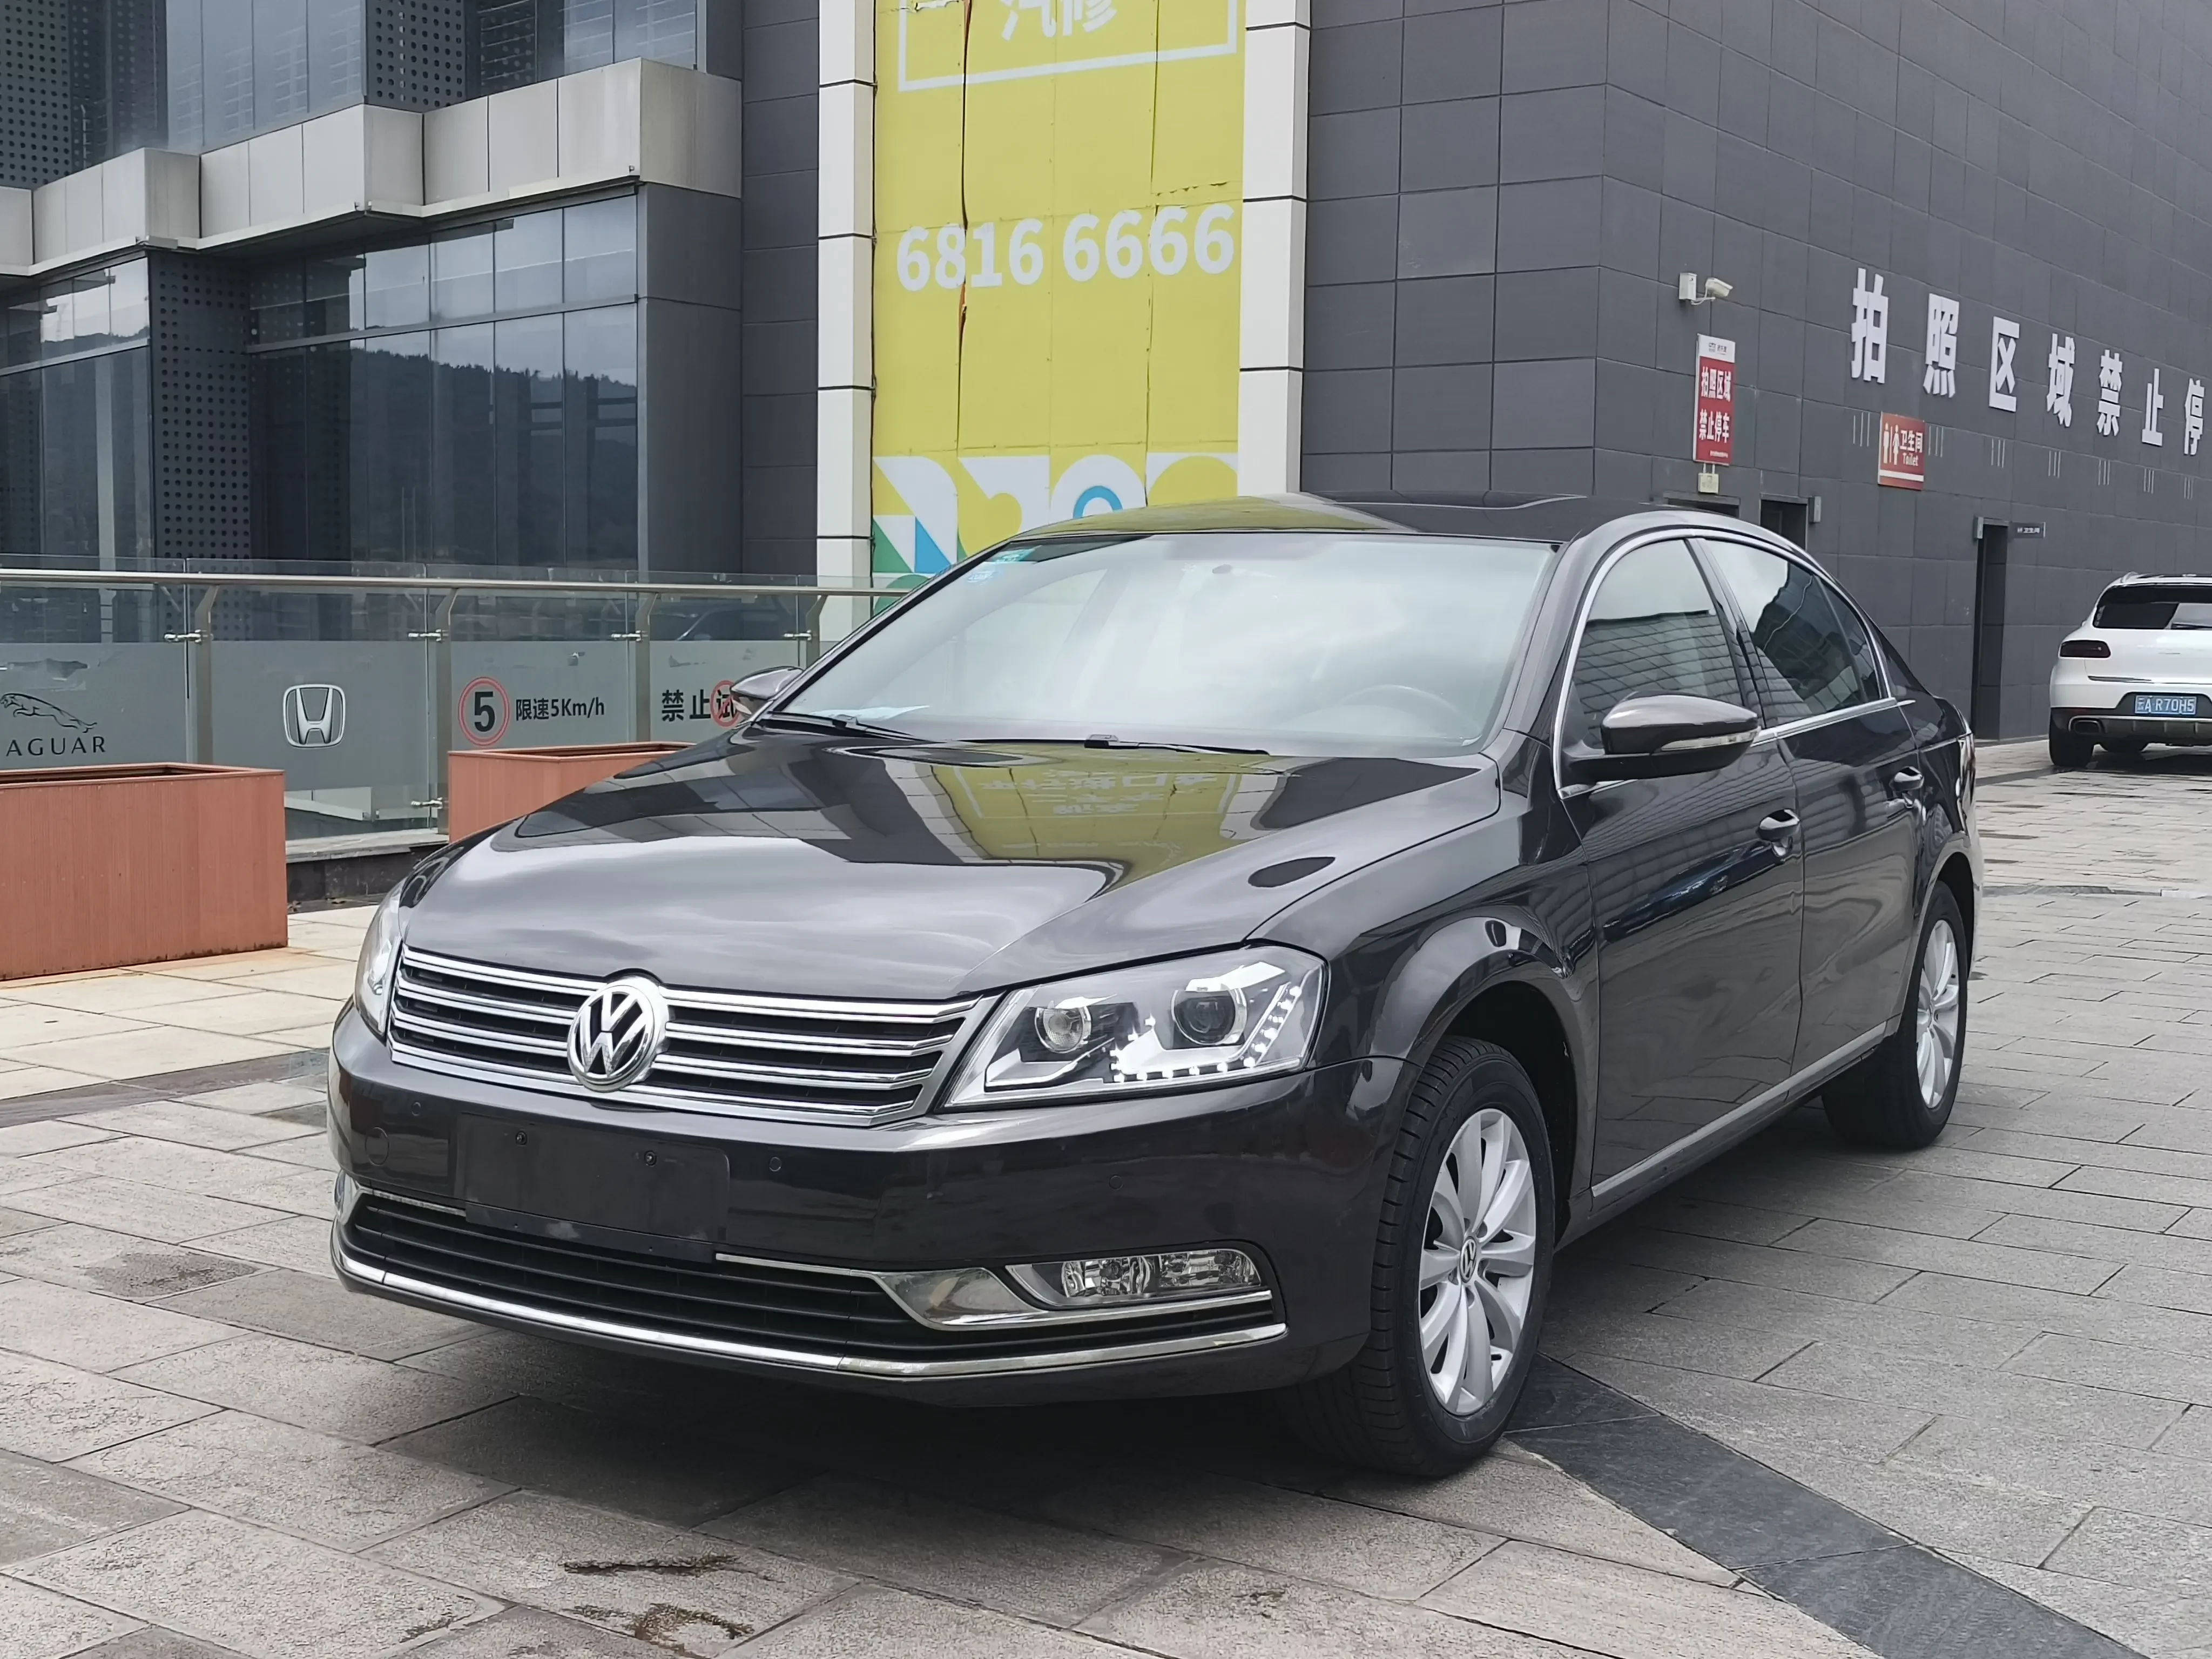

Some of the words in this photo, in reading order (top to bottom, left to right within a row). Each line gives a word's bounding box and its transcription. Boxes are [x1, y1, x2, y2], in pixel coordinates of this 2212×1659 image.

[896, 218, 1044, 292] 6816
[1063, 204, 1235, 282] 6666
[1851, 267, 2205, 456] 拍照区域禁止停
[1701, 366, 1731, 402] 拍照区域
[1699, 408, 1730, 443] 禁止停车
[1900, 430, 1923, 453] 卫生间
[1903, 453, 1919, 467] Toilet
[474, 691, 496, 733] 5
[6, 736, 106, 757] AGUAR
